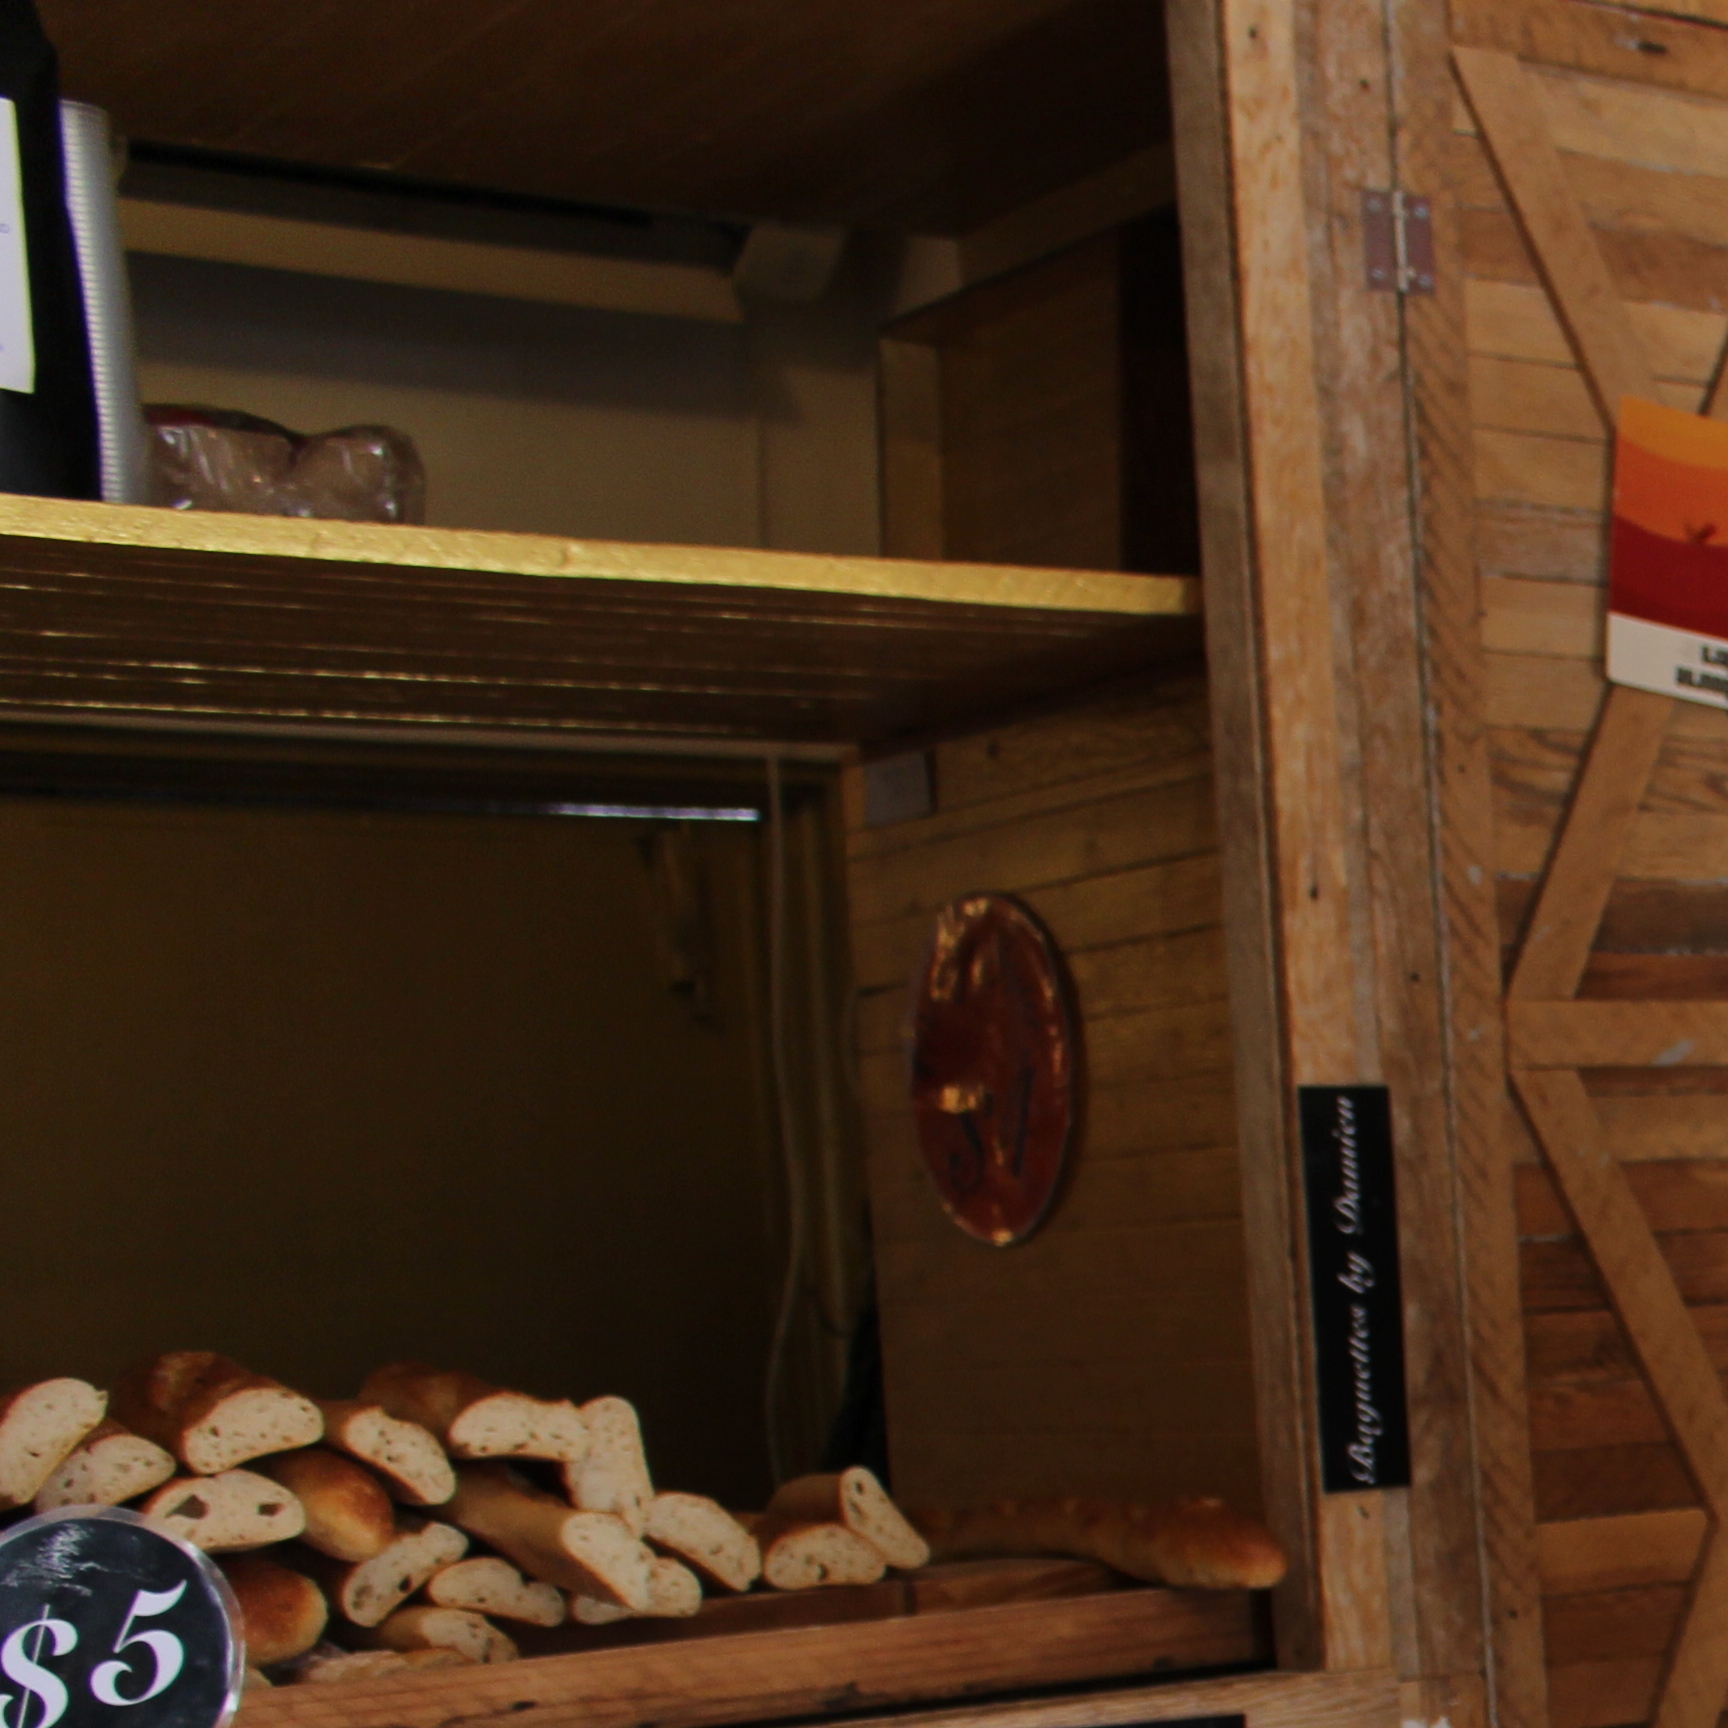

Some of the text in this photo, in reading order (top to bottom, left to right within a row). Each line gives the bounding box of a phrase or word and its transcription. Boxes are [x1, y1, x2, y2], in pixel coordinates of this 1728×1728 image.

[1331, 1094, 1384, 1485] Baguettes by Damien
